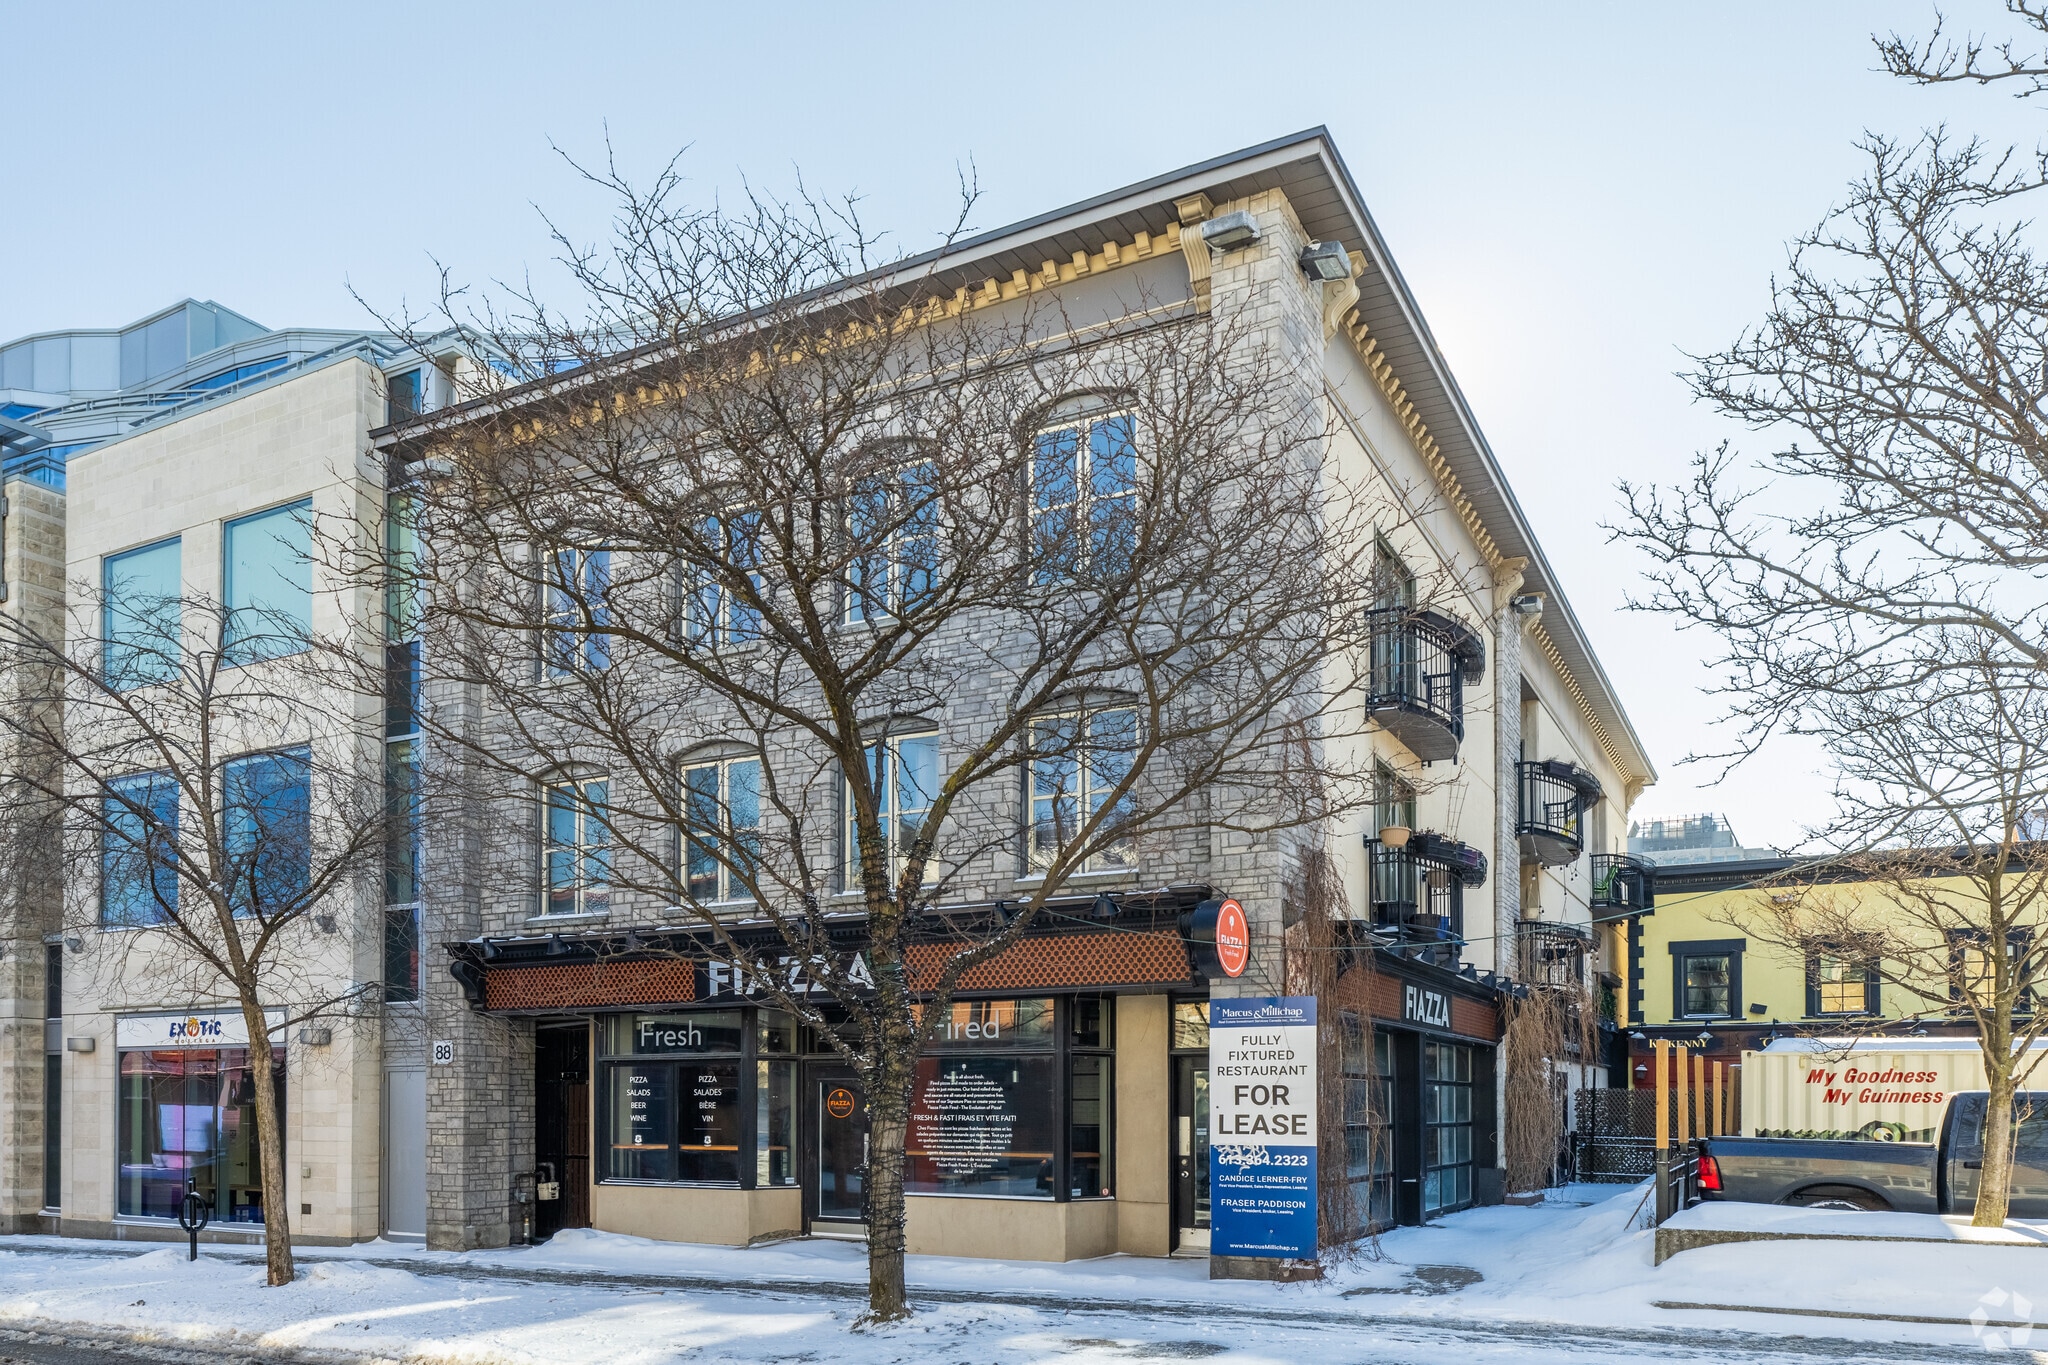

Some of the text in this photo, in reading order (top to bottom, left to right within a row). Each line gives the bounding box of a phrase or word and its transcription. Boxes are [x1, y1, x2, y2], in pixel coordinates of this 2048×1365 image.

[1220, 934, 1243, 950] FIAZZA
[708, 951, 876, 996] FIAZZA
[1222, 1006, 1302, 1018] Marcus & Millichap
[1406, 985, 1450, 1028] FIAZZA
[936, 1009, 1000, 1040] ired
[641, 1020, 701, 1046] Fresh
[1242, 1035, 1281, 1045] FULLY
[1649, 1039, 1709, 1048] KKENNY
[436, 1045, 450, 1059] 88
[1229, 1050, 1294, 1060] FIXTURED
[1218, 1065, 1308, 1076] RESTAURANT
[1806, 1068, 1938, 1086] My Goodness
[1235, 1084, 1290, 1105] FOR
[1823, 1088, 1944, 1106] My Guinness
[699, 1100, 716, 1109] BIÈRE
[1219, 1114, 1307, 1135] LEASE
[1221, 1198, 1306, 1208] FRASER PADDISON
